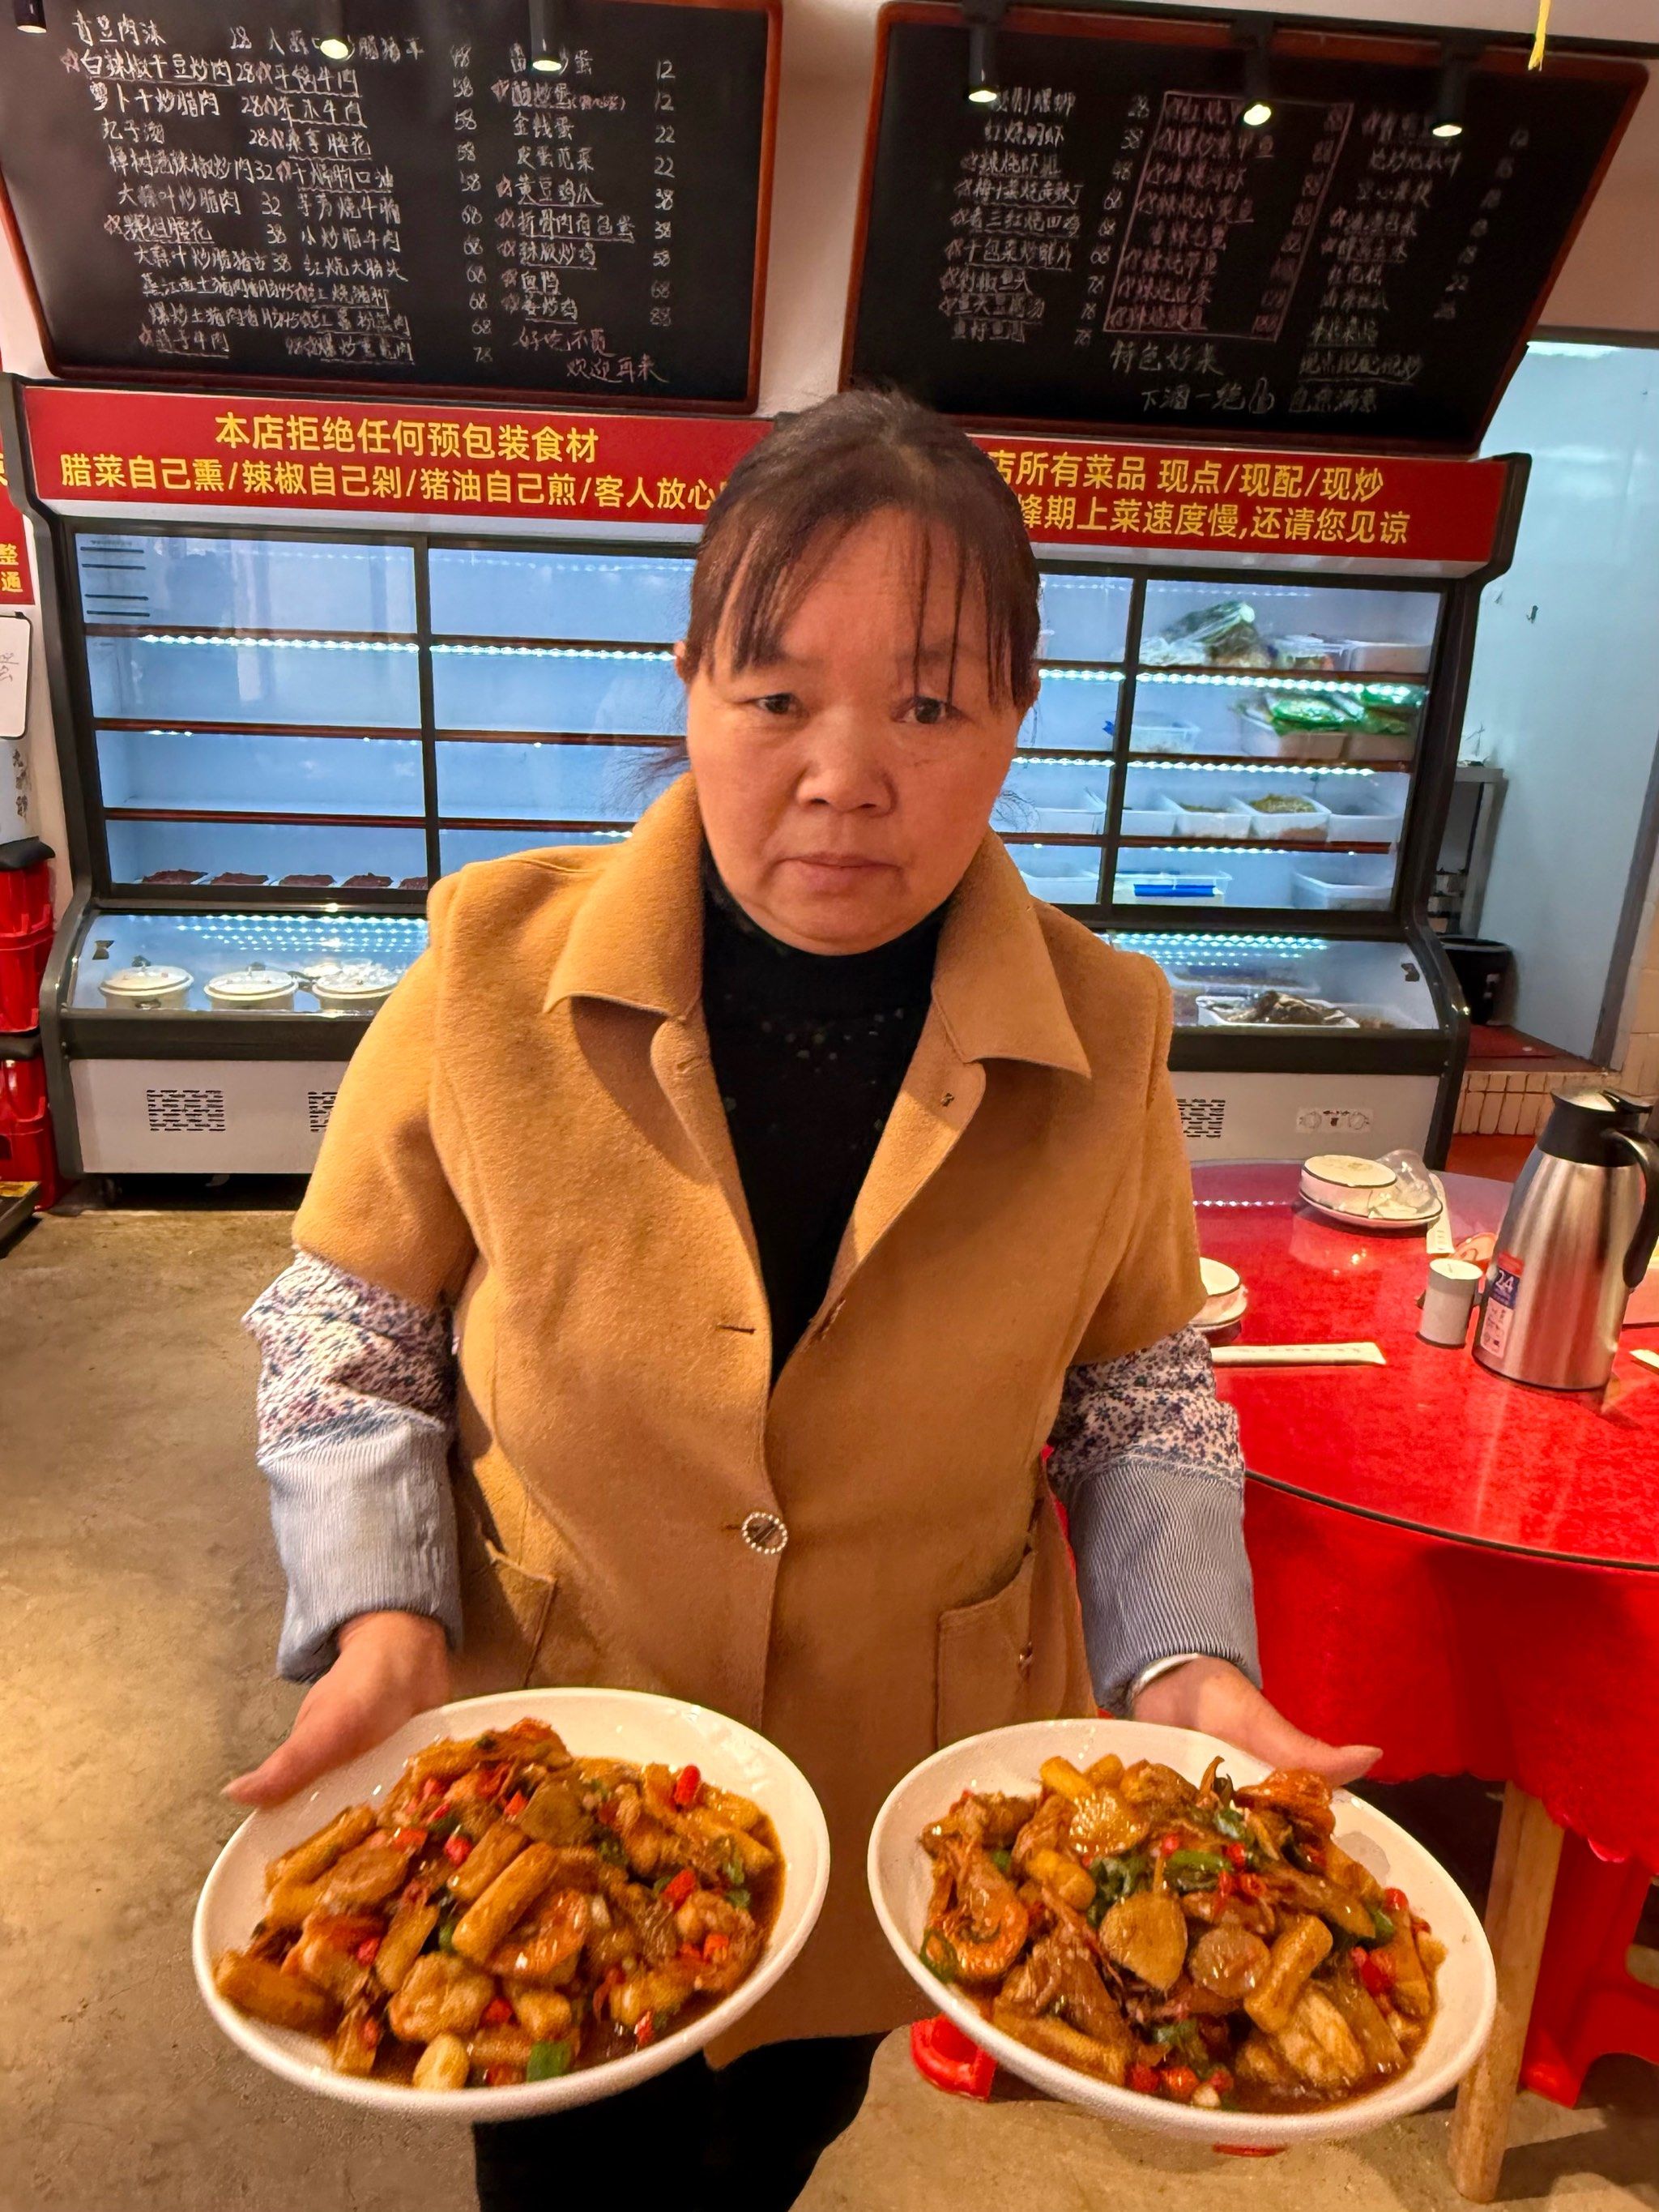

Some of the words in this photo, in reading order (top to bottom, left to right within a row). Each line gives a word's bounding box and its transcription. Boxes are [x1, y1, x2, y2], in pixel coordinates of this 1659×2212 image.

[454, 108, 478, 130] 58
[655, 125, 676, 143] 22
[254, 160, 275, 181] 32
[654, 156, 676, 178] 22
[260, 191, 283, 216] 32
[267, 224, 288, 244] 38
[469, 292, 488, 310] 68
[471, 318, 493, 335] 68
[512, 325, 617, 357] 好吃不贵
[566, 352, 671, 384] 欢迎再来
[215, 411, 599, 464] 本店拒绝任何预包装食材
[60, 453, 728, 512] 腊菜自己熏/辣椒自己剁/猪油自己煎/客人放心
[1157, 459, 1384, 502] 现点/现配/现炒
[1495, 1269, 1515, 1293] 24
